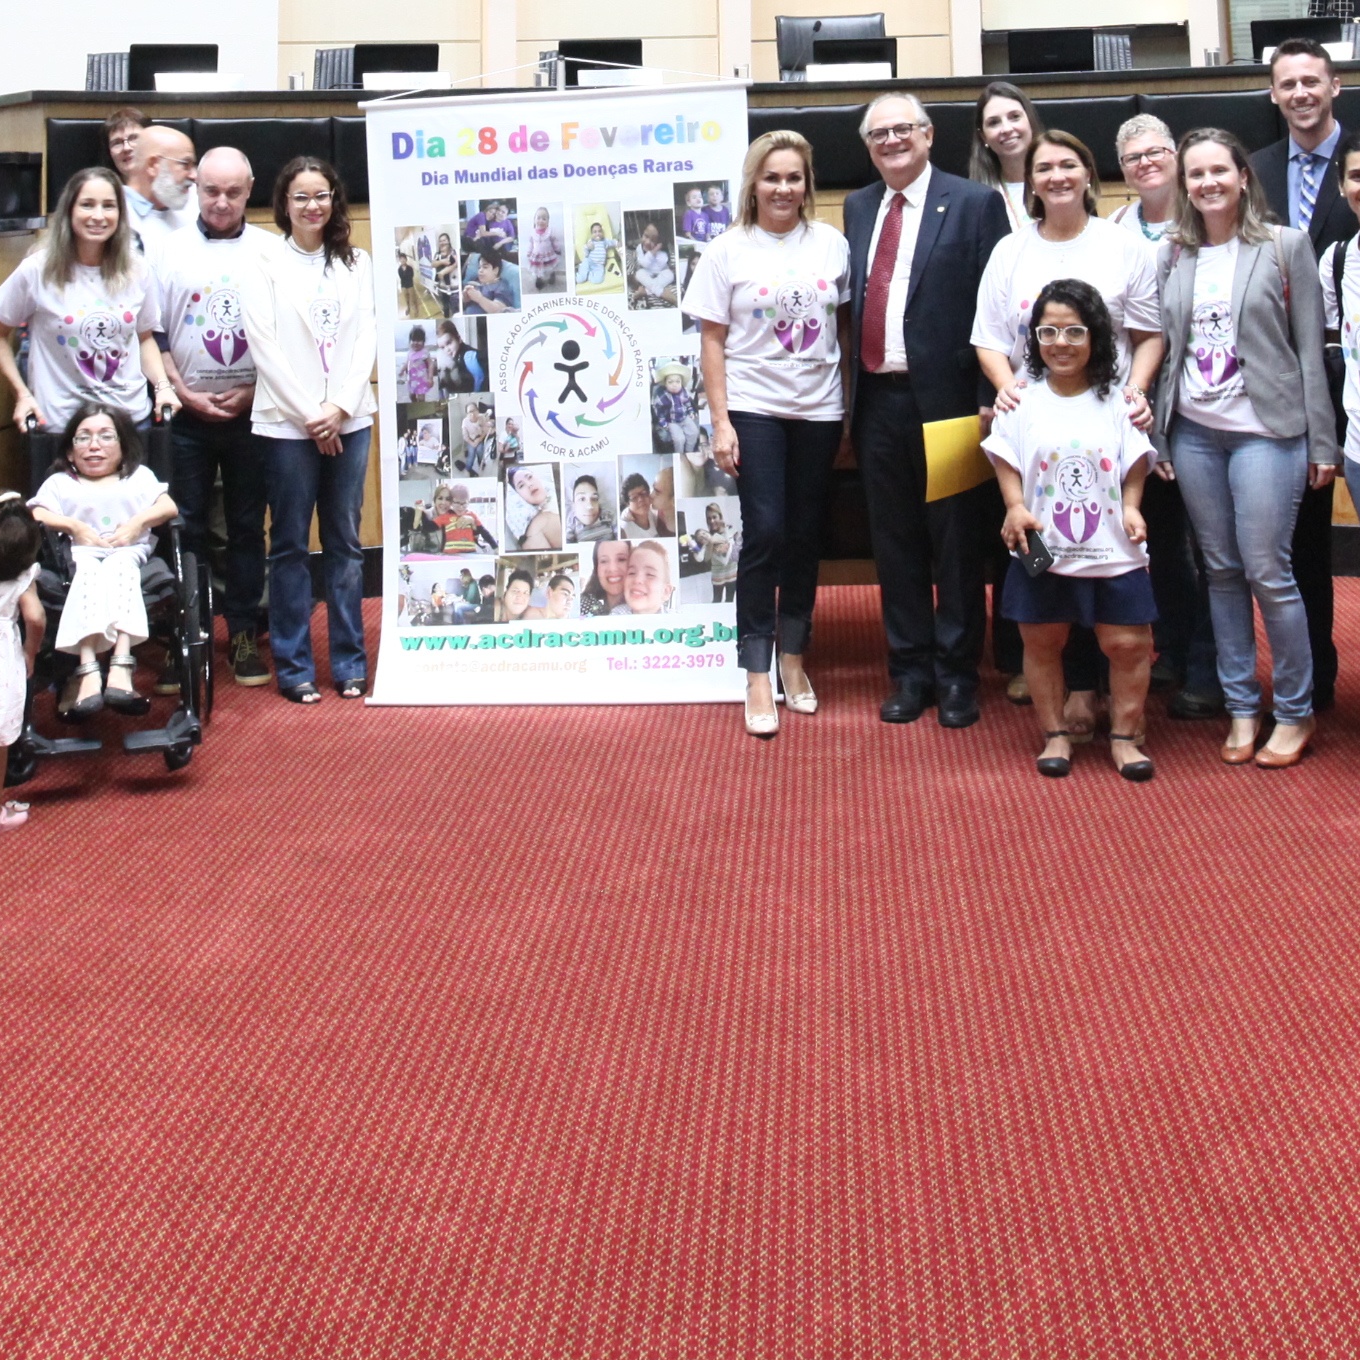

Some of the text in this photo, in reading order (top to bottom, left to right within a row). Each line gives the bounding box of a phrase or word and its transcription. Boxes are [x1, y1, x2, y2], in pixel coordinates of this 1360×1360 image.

[391, 114, 722, 160] Dia 28 de Fevereiro
[421, 158, 694, 186] Dia Mundial das Doenças Raras
[499, 297, 644, 393] ASSOCIAÇÃO CATARINENSE DE DOENÇAS RARAS
[539, 437, 610, 458] ACDR & ACAMU
[606, 657, 637, 671] Tel.:
[642, 653, 725, 670] 3222-3979
